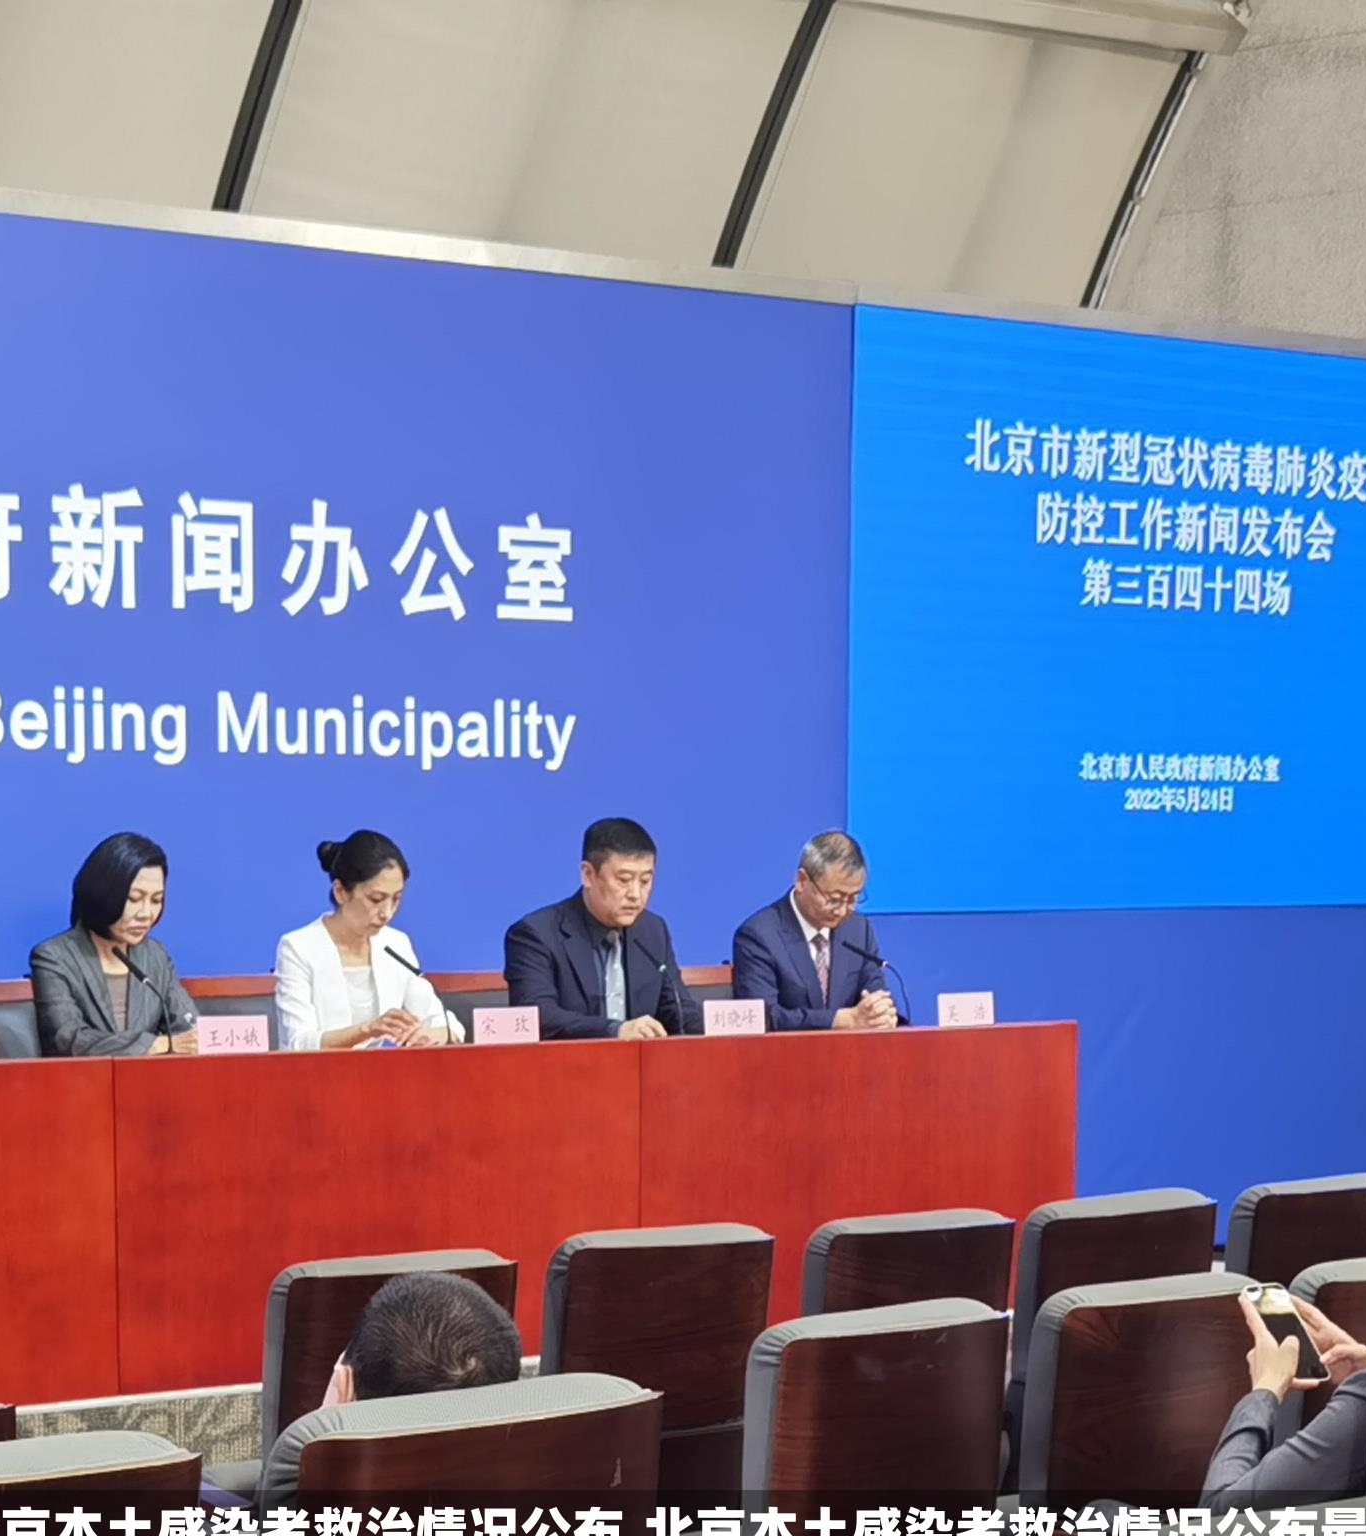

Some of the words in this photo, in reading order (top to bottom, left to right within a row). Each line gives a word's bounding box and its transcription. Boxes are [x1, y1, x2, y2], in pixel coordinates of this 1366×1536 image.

[1035, 491, 1336, 562] 防控工作新闻发布会
[1080, 558, 1291, 616] 第三百四十四场
[216, 690, 577, 772] Municipality
[1078, 751, 1281, 784] 北京市人民政府新闻办公室
[1123, 785, 1235, 814] 2022年5月24日
